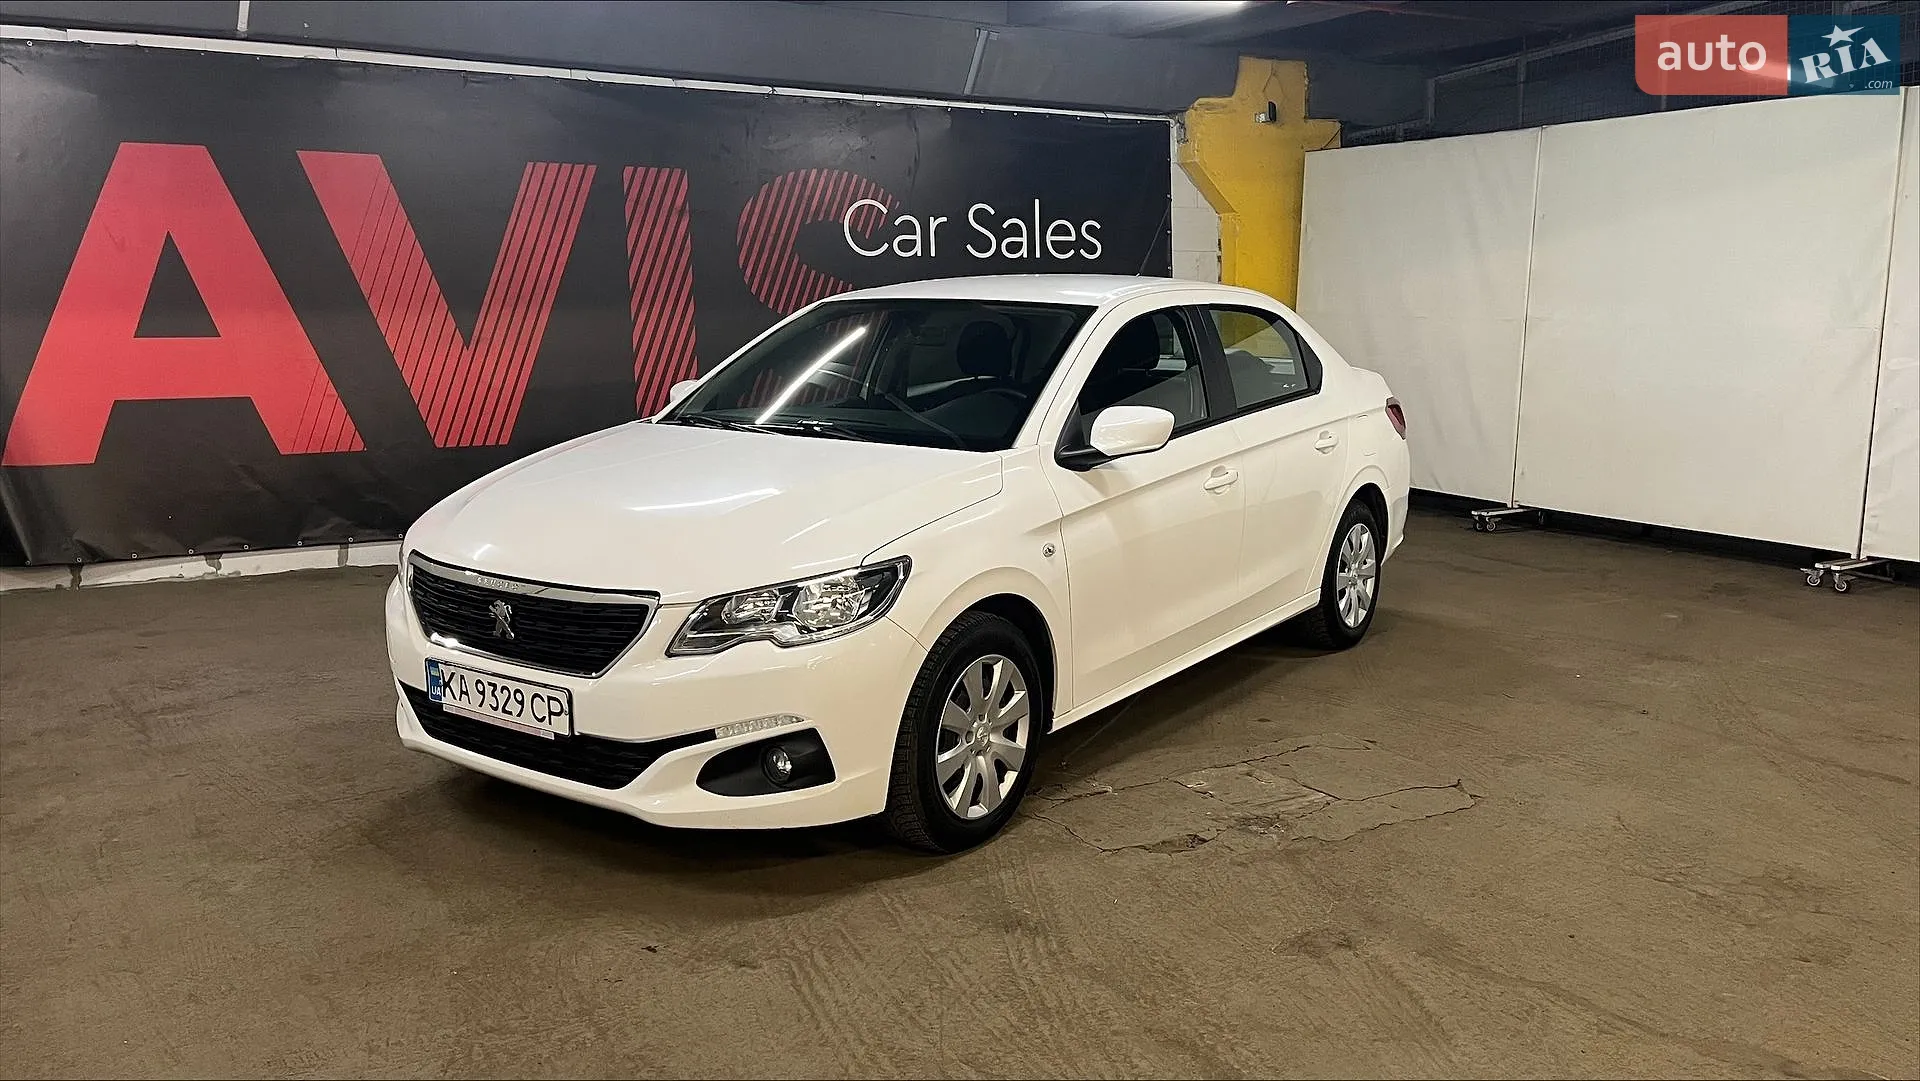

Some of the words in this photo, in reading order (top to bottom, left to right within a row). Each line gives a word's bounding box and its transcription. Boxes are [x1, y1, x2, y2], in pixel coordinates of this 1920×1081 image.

[842, 198, 948, 258] Car
[965, 198, 1102, 261] Sales
[2, 142, 898, 467] AVIS
[431, 684, 442, 696] UA
[440, 668, 472, 705] KA
[474, 678, 525, 718] 9329
[530, 692, 564, 726] CP
